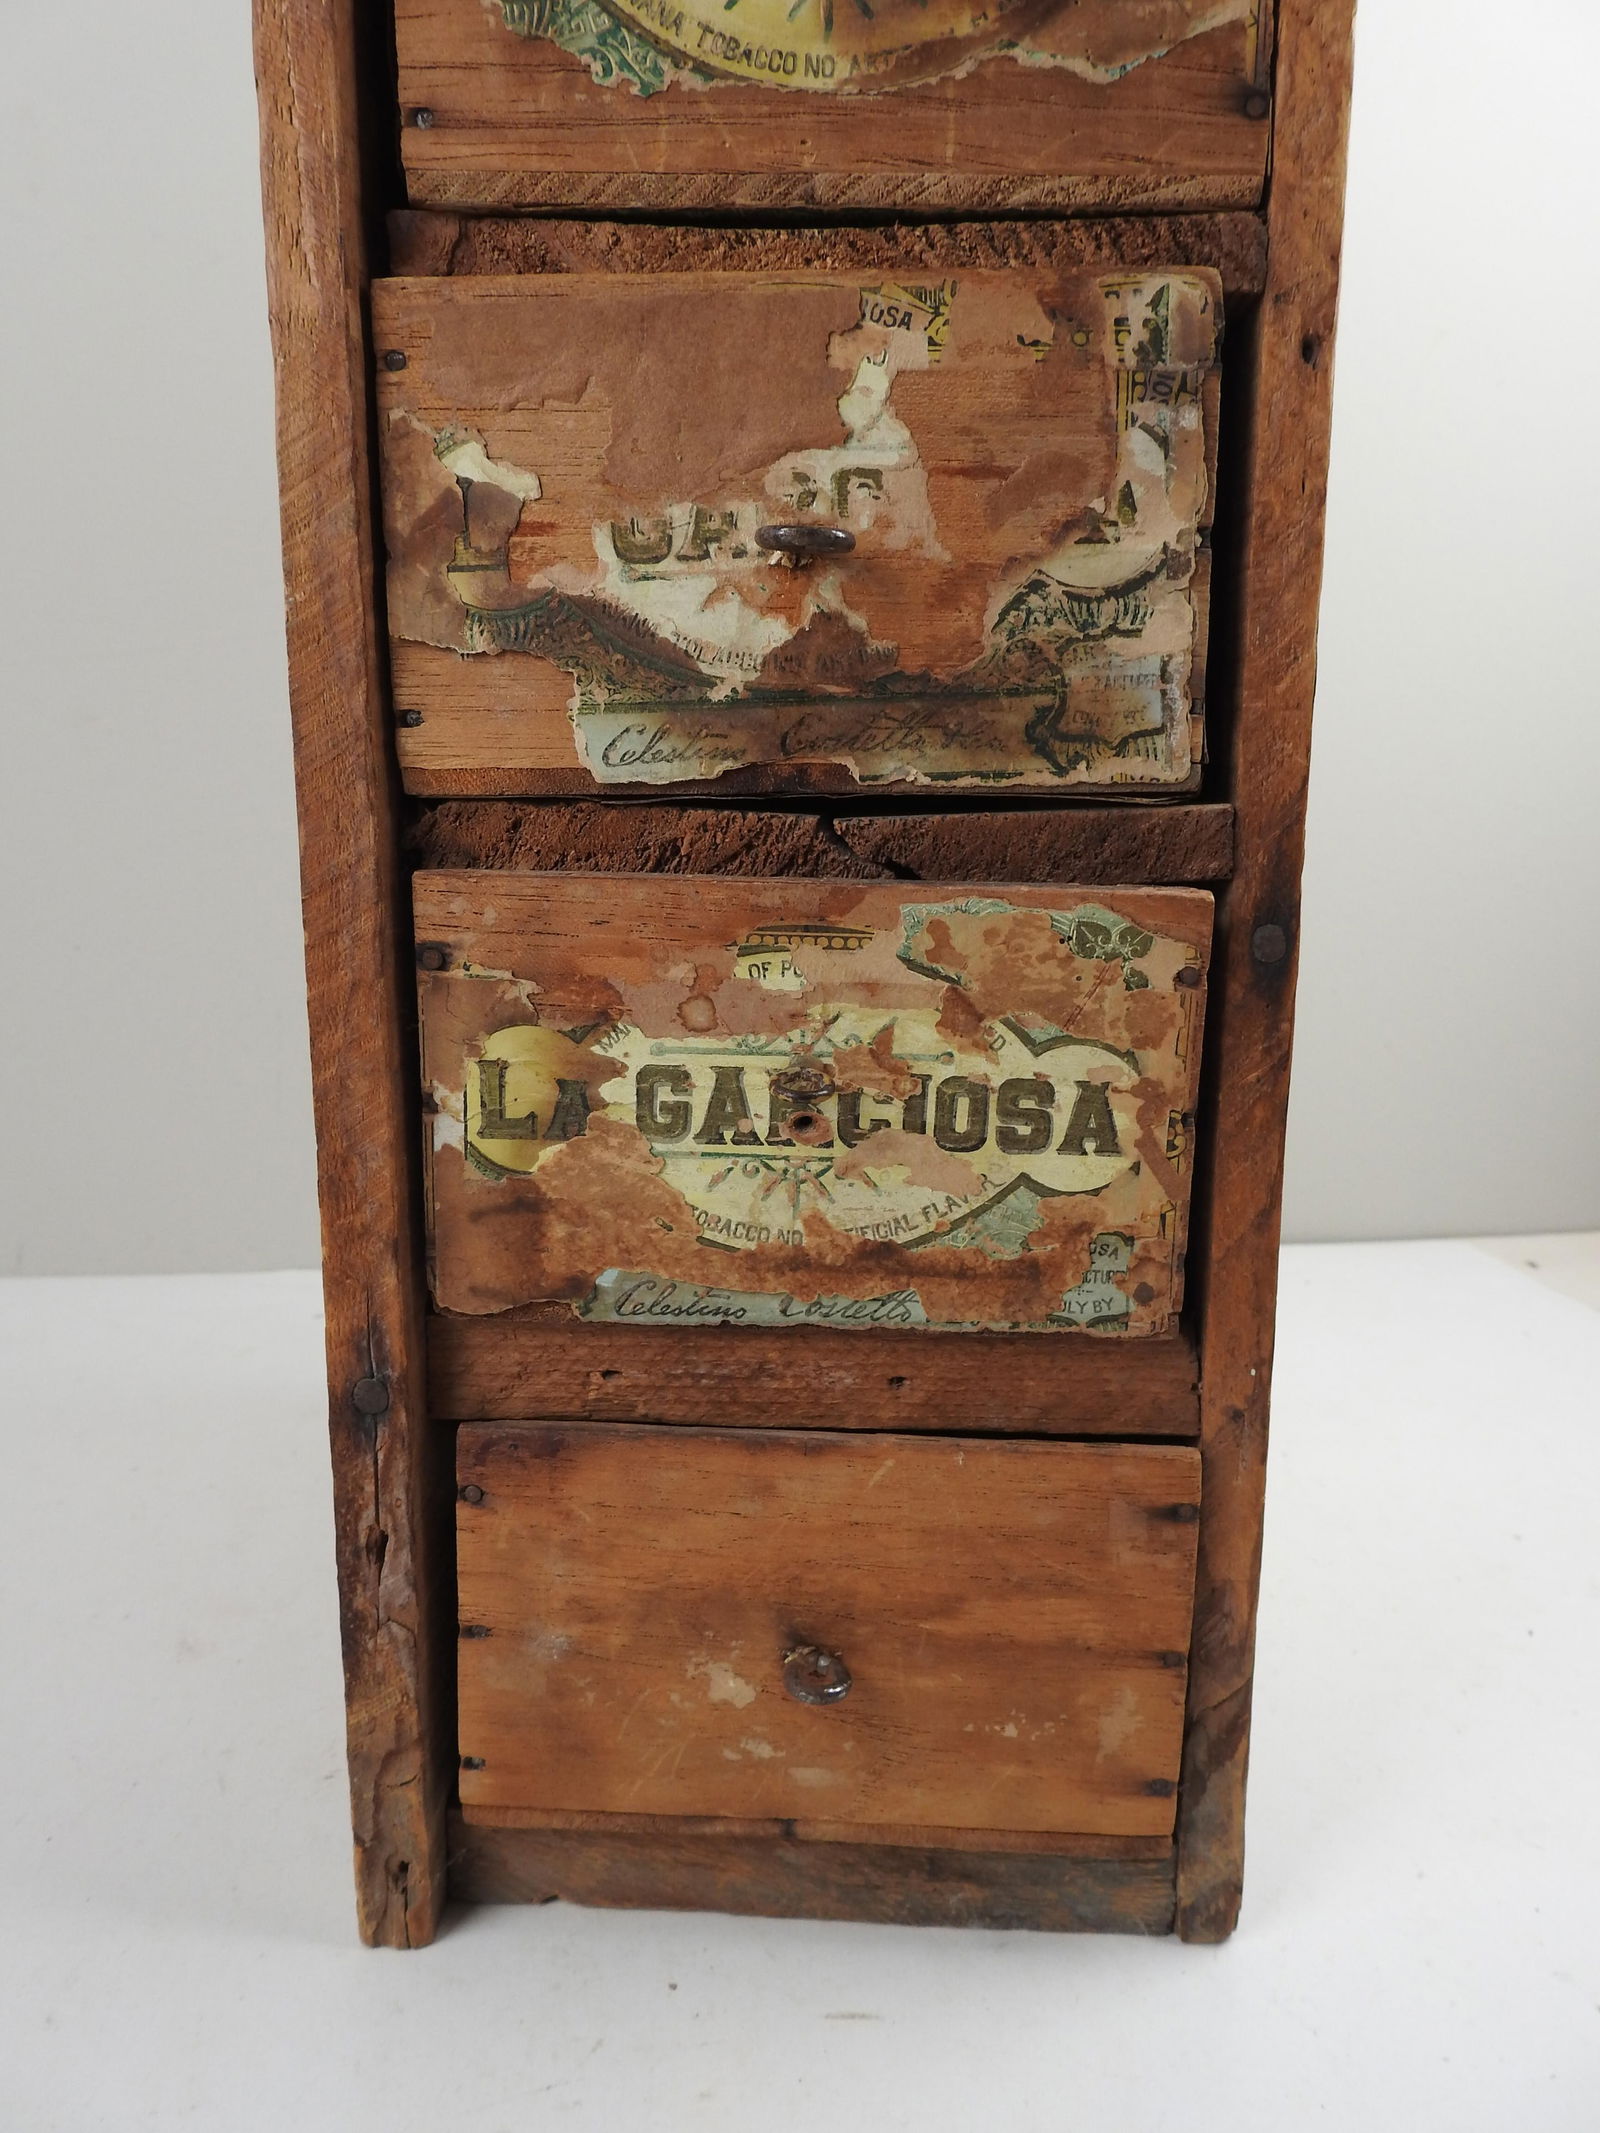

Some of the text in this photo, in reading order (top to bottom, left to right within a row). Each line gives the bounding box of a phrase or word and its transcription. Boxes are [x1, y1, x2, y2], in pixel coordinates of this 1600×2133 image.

[697, 21, 798, 75] TOBACCO
[804, 52, 836, 79] NO
[748, 961, 772, 980] OF
[777, 1228, 803, 1246] NO
[614, 1279, 747, 1320] Celestino
[1093, 1297, 1113, 1314] BY
